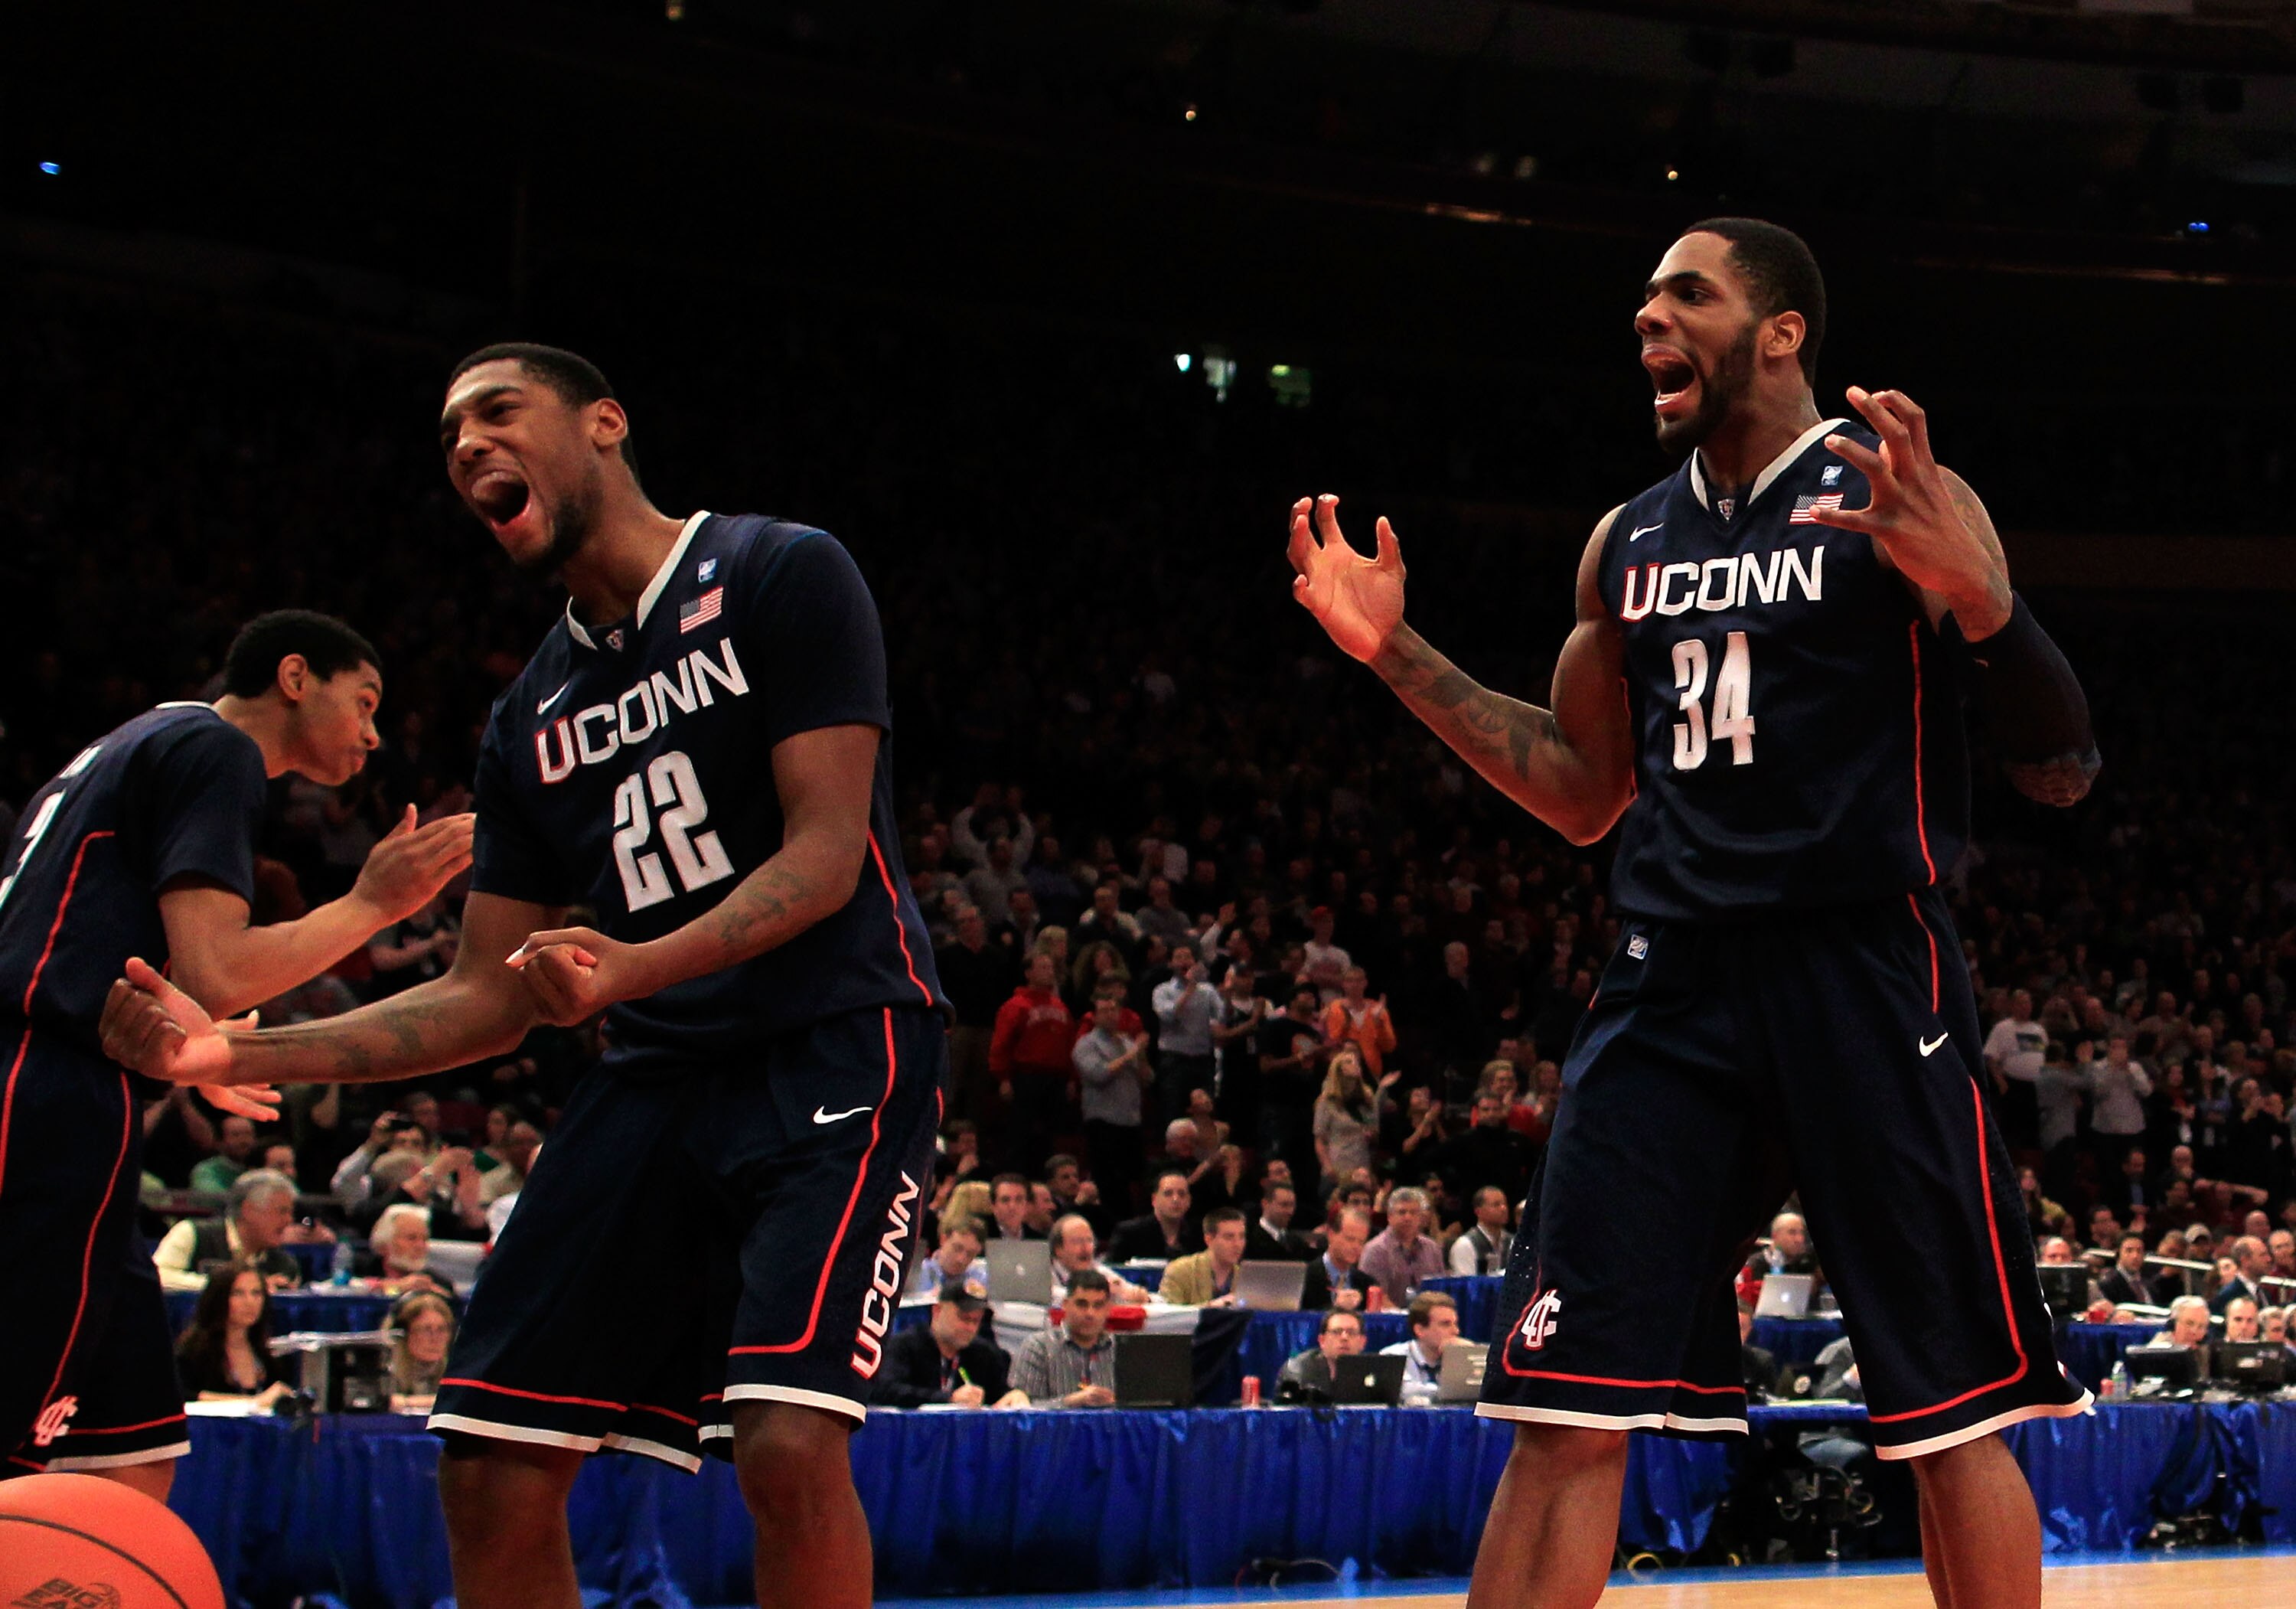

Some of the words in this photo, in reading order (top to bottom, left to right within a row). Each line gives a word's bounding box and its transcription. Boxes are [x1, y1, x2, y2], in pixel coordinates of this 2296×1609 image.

[1619, 544, 1825, 622] UCONN
[533, 637, 749, 785] UCONN
[1671, 630, 1756, 771] 34
[612, 750, 735, 914] 22
[850, 1169, 920, 1381] UCONN
